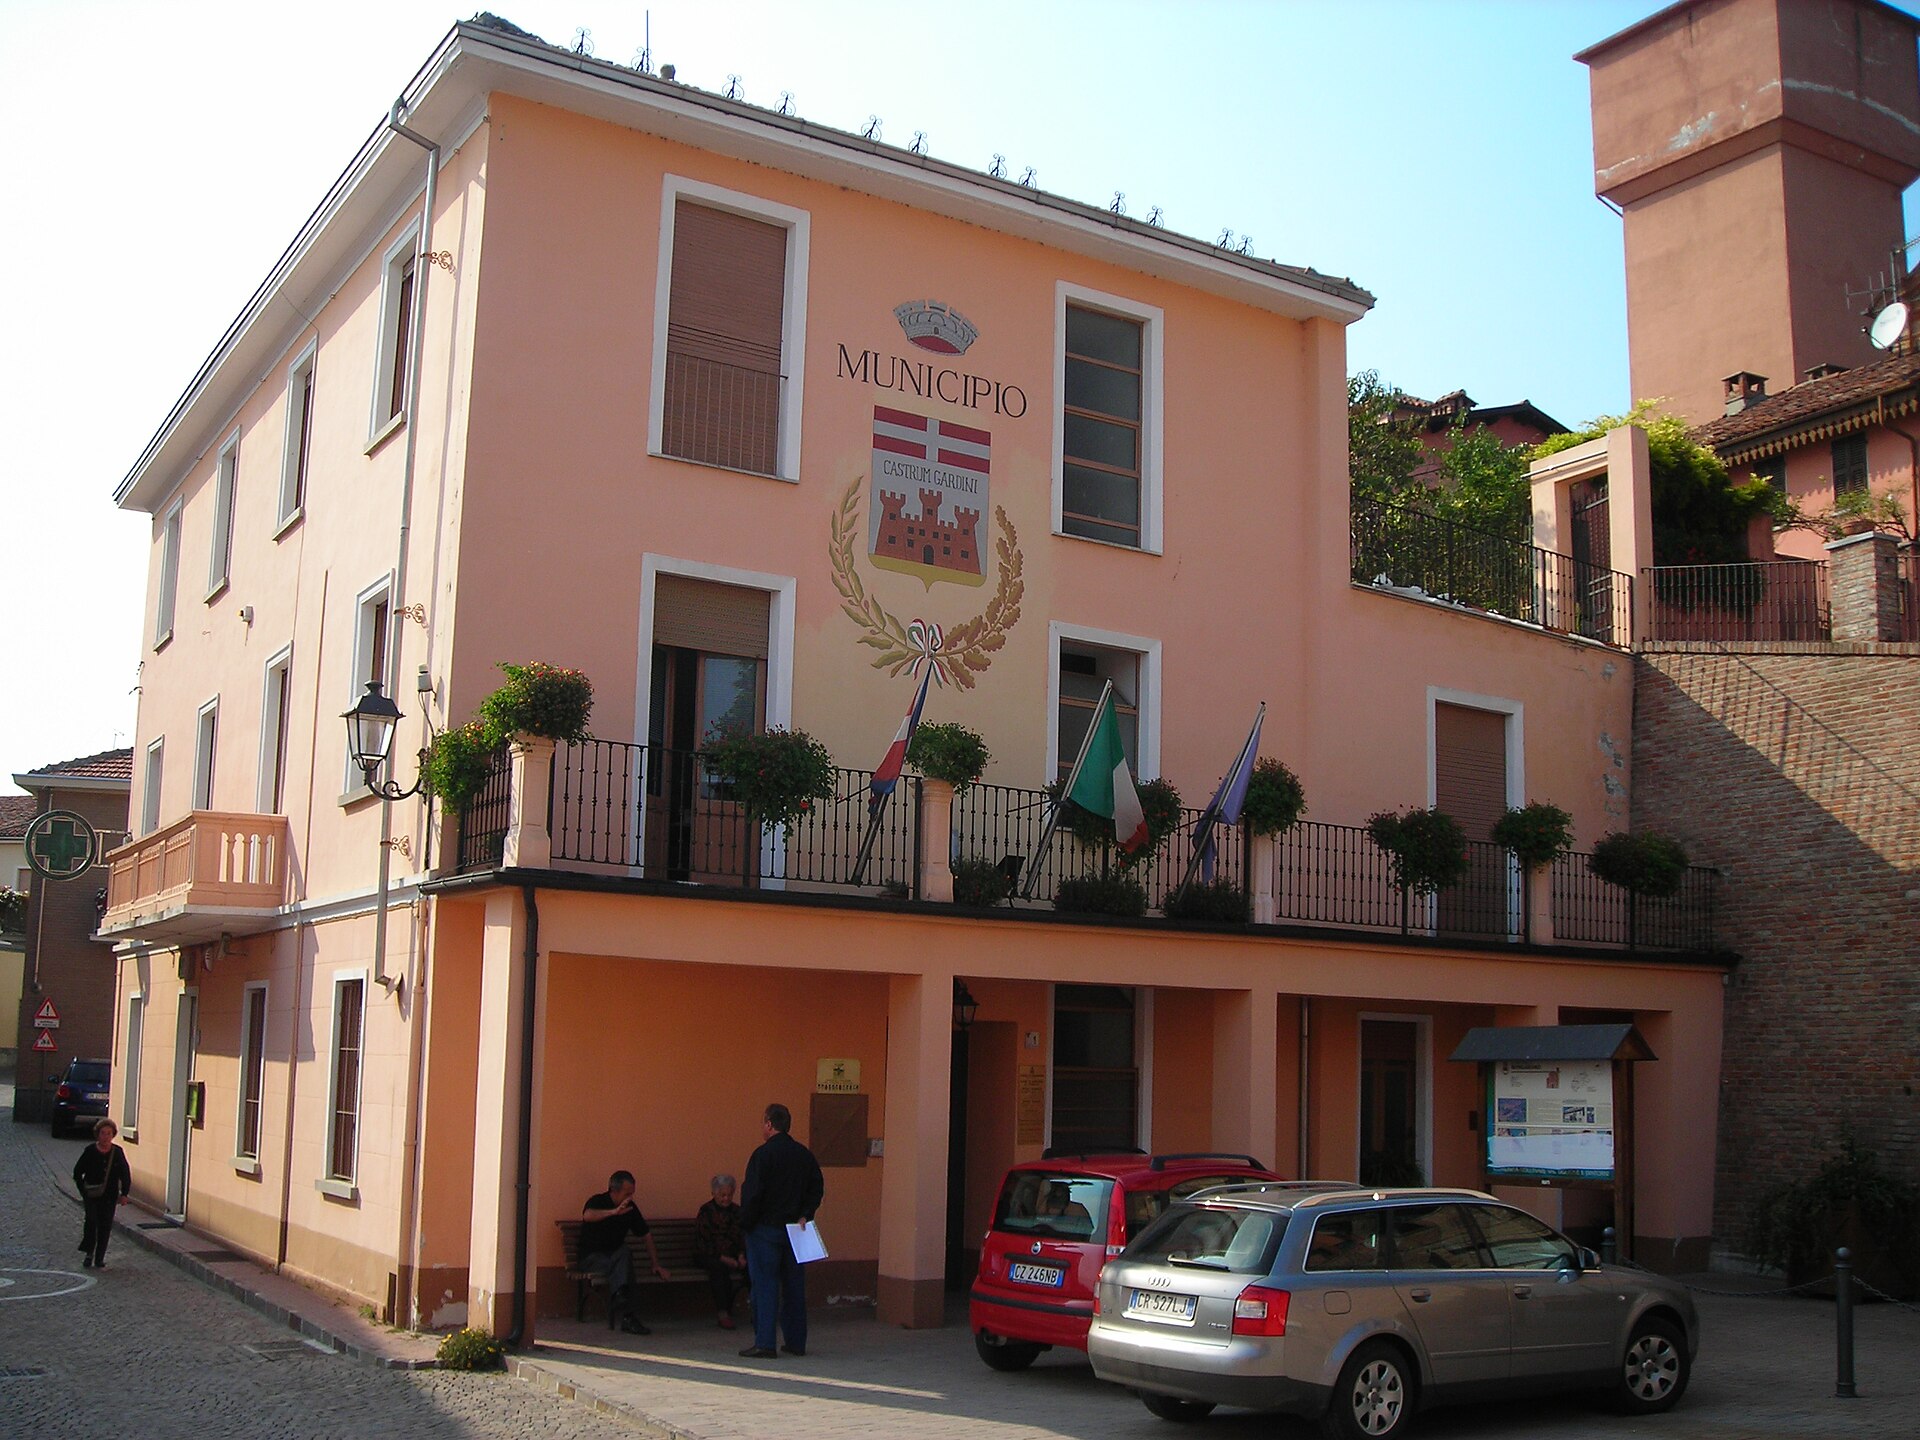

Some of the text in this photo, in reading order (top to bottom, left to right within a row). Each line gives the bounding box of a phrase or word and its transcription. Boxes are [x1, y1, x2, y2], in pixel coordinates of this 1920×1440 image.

[836, 343, 1027, 418] MUNICIPIO
[883, 460, 978, 494] CASTRUM GARDINI
[1014, 1265, 1058, 1283] CZ 246NB
[1137, 1293, 1188, 1314] CR 527LJ
